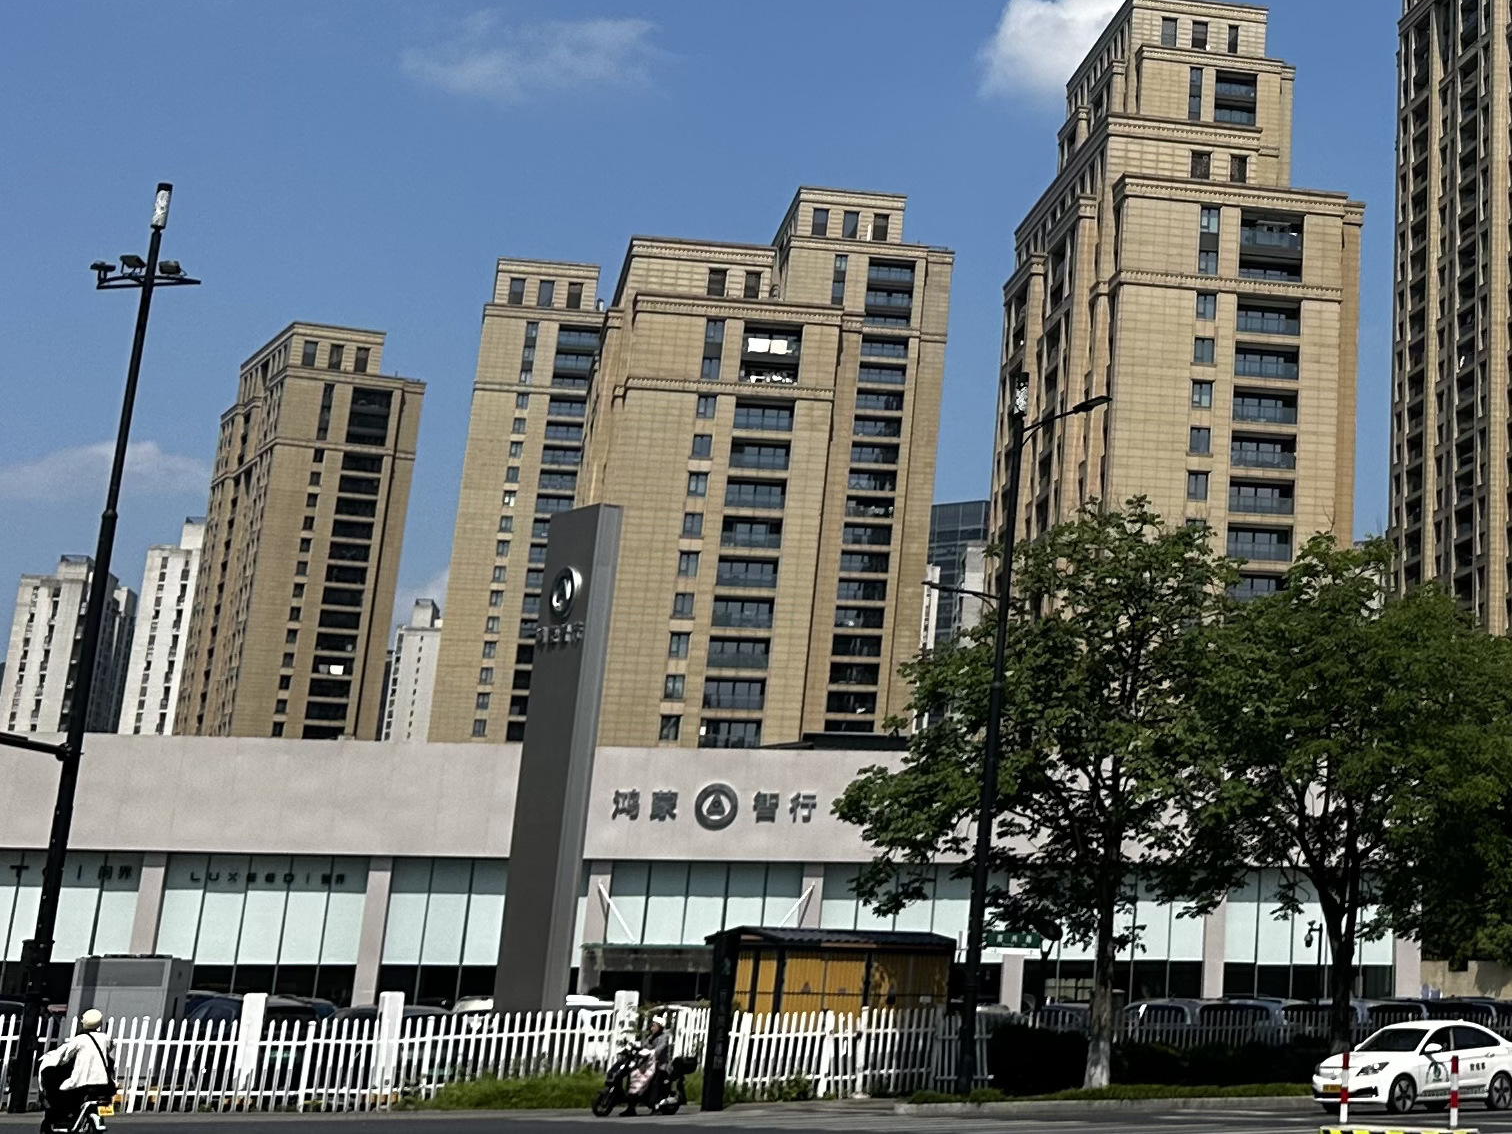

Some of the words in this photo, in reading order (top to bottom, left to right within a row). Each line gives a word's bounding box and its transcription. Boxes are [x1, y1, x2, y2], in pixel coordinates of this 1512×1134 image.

[612, 788, 678, 822] 鸿蒙
[753, 791, 817, 823] 智行
[190, 871, 295, 884] LUXEED
